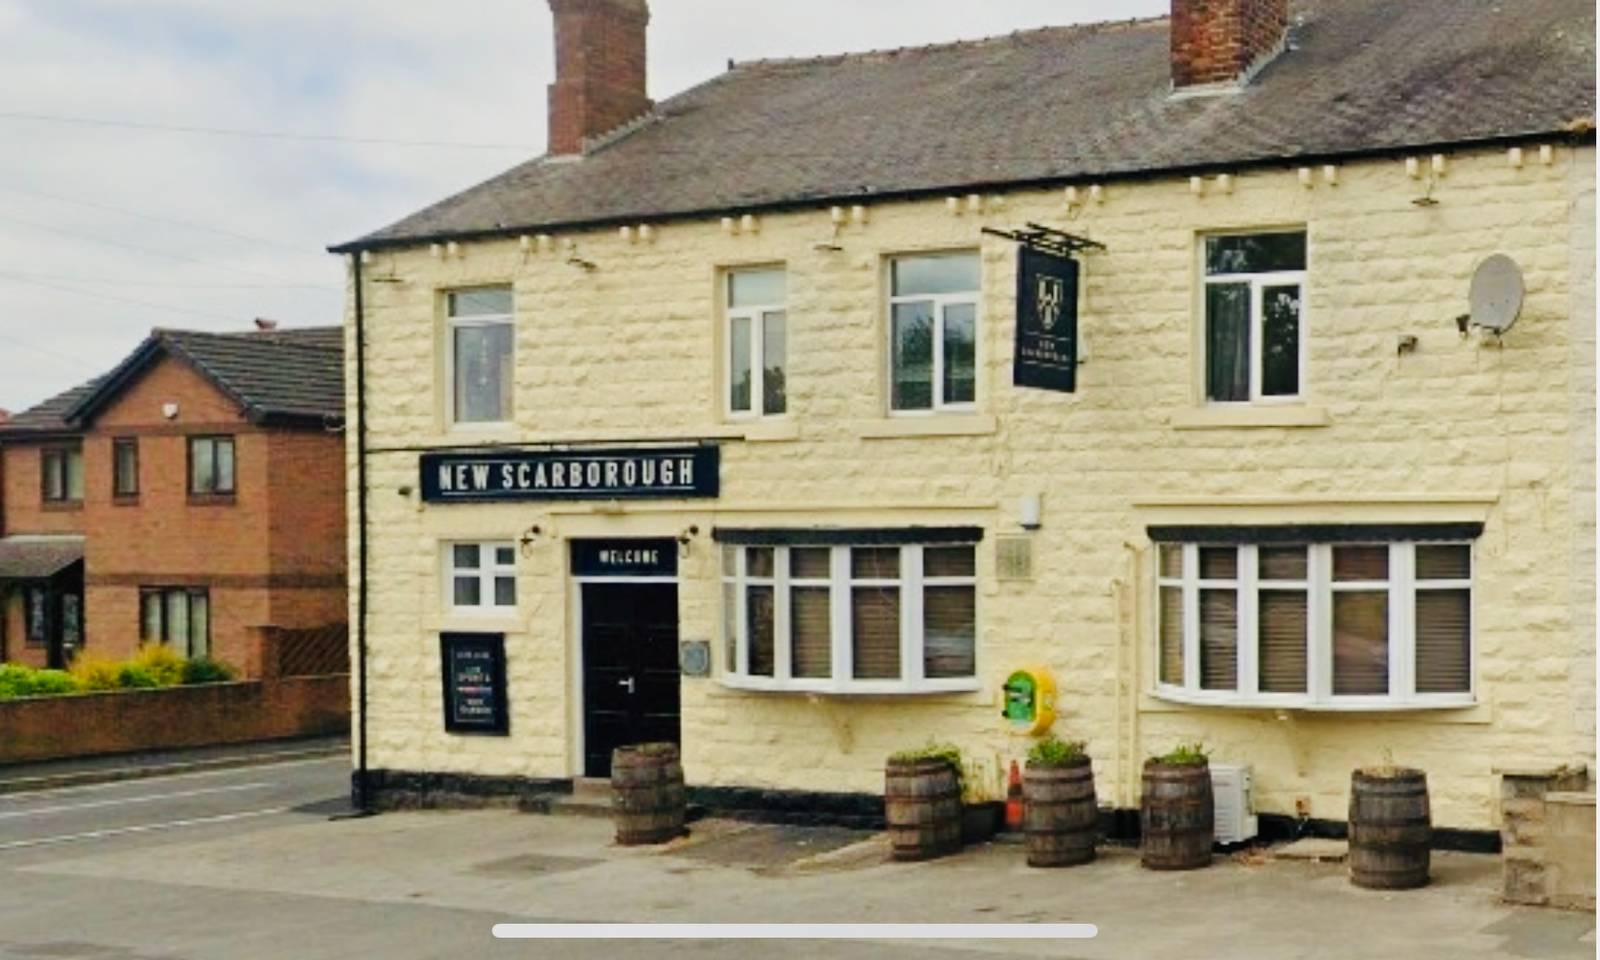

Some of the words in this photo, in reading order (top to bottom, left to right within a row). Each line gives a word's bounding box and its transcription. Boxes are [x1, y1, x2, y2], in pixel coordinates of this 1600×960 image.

[438, 465, 489, 490] NEW
[502, 459, 694, 488] SCARBOROUGH
[599, 549, 659, 564] WELCOME
